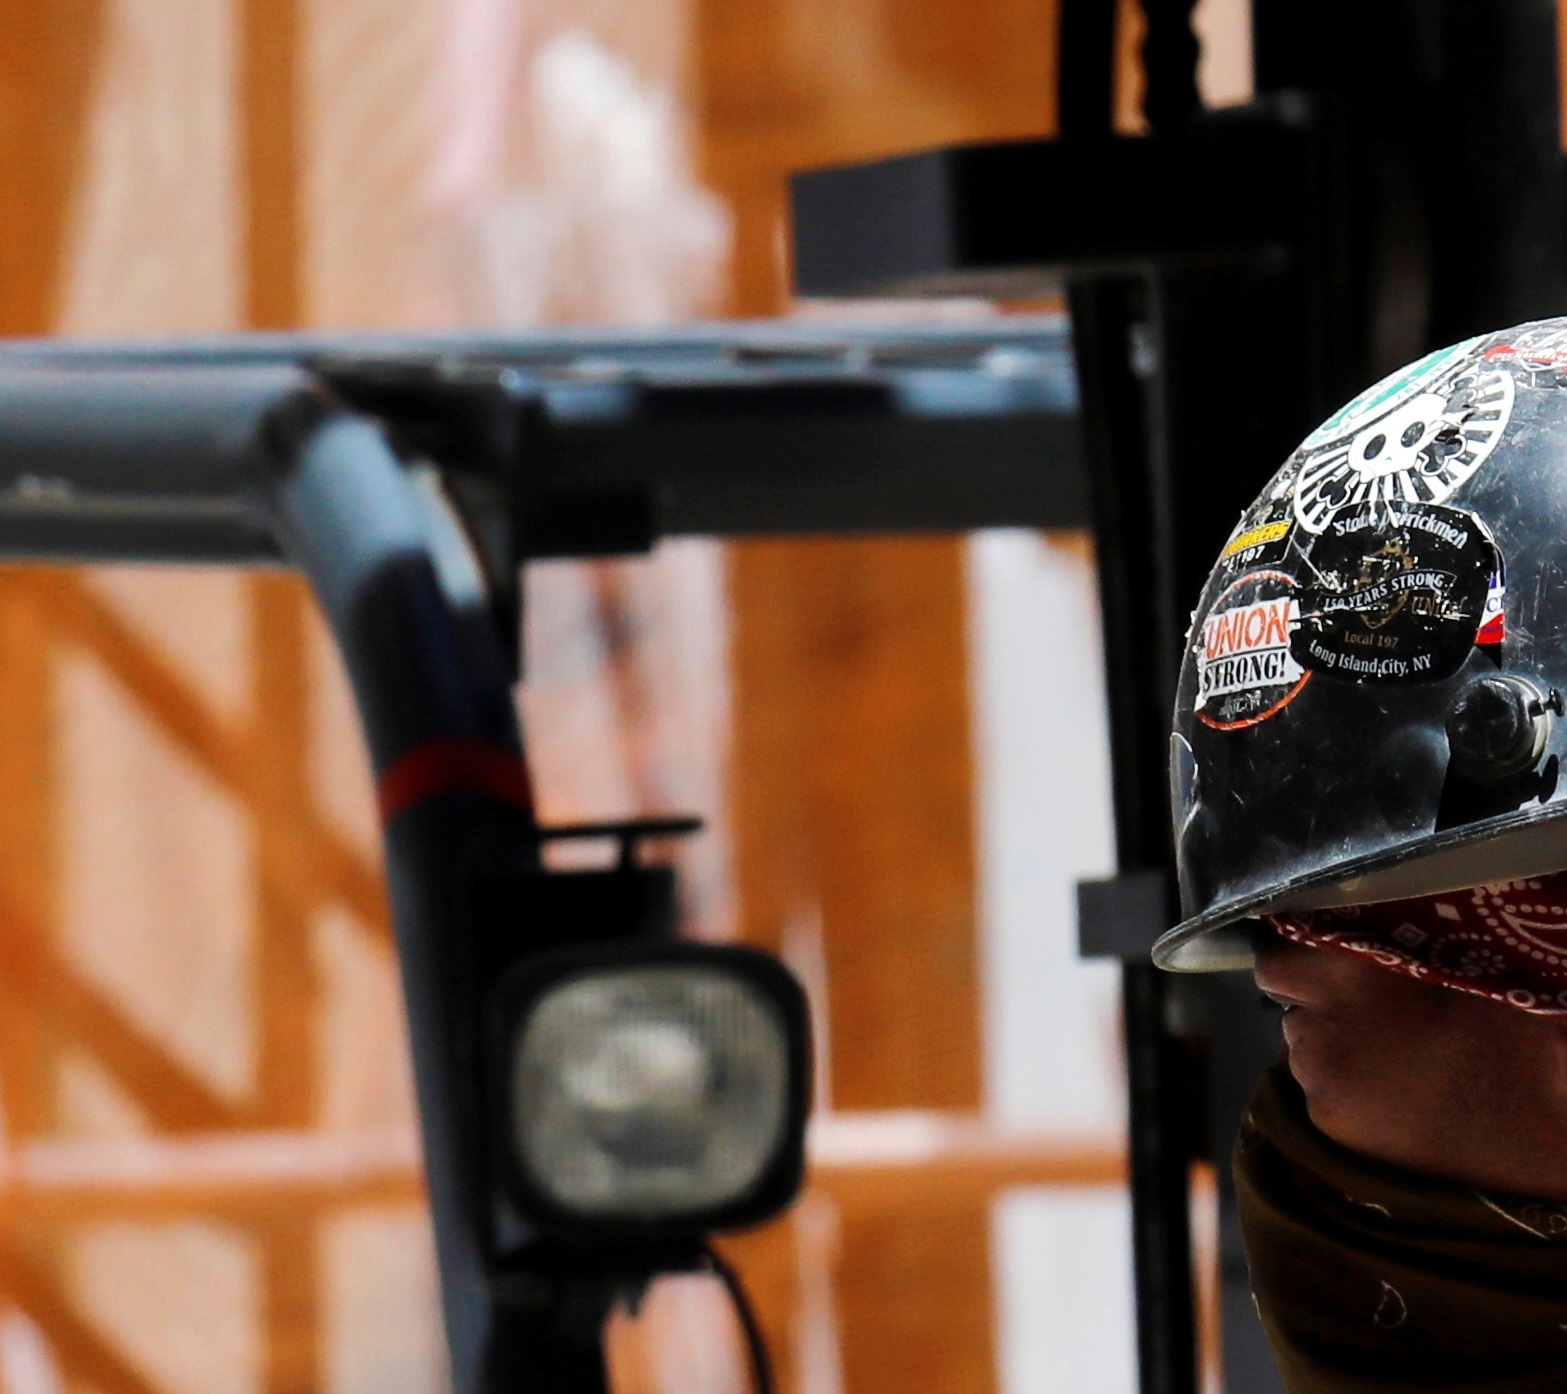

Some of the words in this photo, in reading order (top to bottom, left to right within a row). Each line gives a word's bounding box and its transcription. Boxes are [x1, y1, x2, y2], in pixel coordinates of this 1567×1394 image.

[1348, 585, 1388, 608] YEARS
[1392, 573, 1445, 592] STRONG
[1206, 602, 1290, 659] UNION
[1345, 630, 1373, 646] Local
[1378, 631, 1399, 648] 197
[1203, 651, 1287, 691] STRONG!
[1309, 640, 1336, 668] Long
[1338, 653, 1379, 673] Island
[1413, 654, 1432, 672] NY
